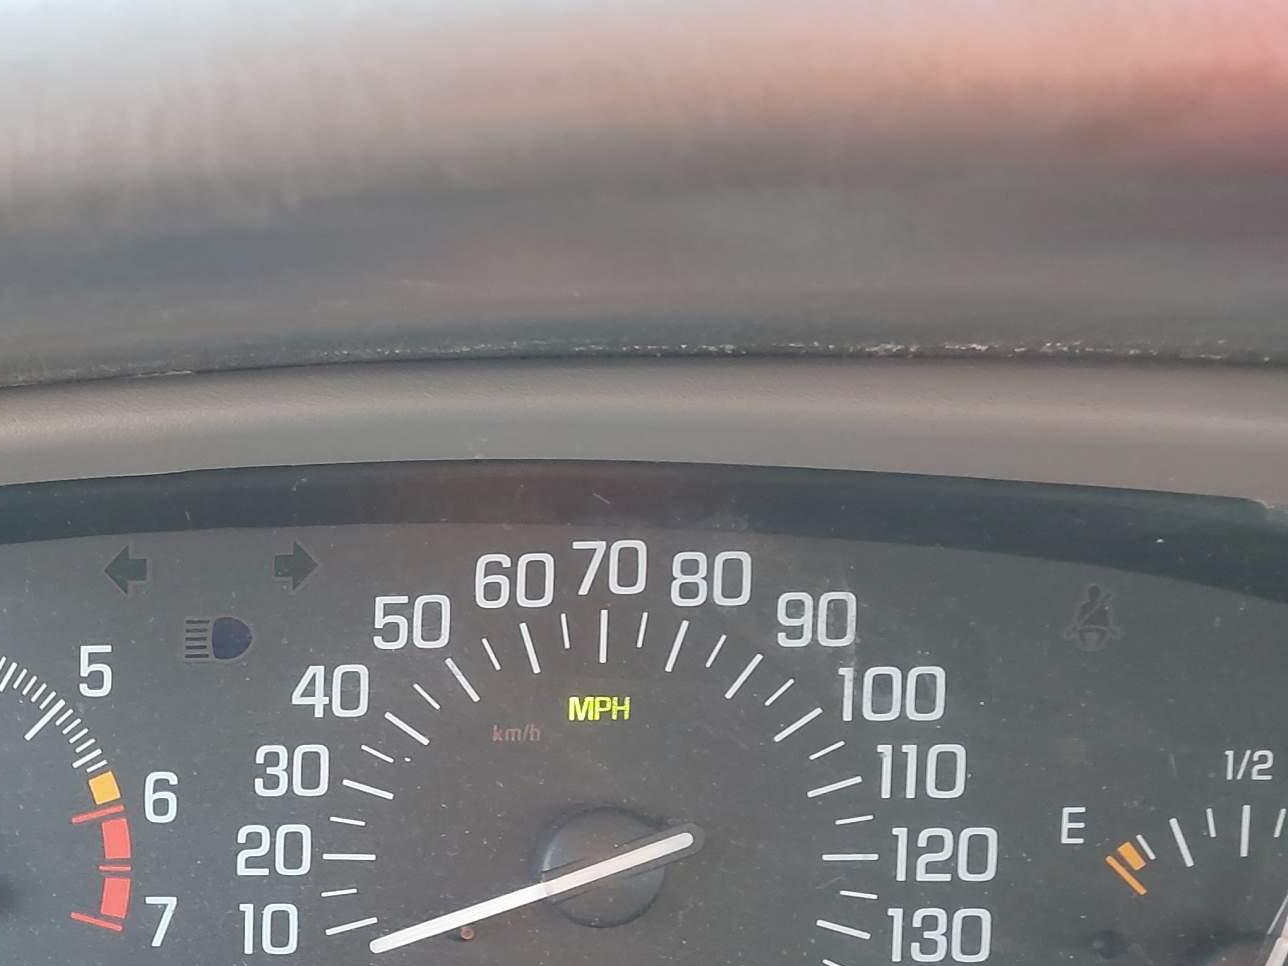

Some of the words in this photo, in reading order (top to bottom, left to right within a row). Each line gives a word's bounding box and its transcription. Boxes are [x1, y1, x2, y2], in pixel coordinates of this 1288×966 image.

[474, 552, 555, 609] 60
[571, 539, 648, 596] 70
[670, 550, 752, 607] 80
[372, 594, 451, 651] 50
[776, 591, 857, 648] 90
[78, 644, 113, 698] 5
[290, 663, 370, 718] 40
[838, 665, 947, 722] 100
[491, 723, 542, 743] km/h
[567, 695, 632, 722] MPH
[253, 744, 330, 798] 30
[876, 743, 968, 800] 110
[1224, 749, 1274, 781] 1/2
[144, 770, 179, 825] 6
[236, 823, 312, 877] 20
[1061, 806, 1087, 845] E
[891, 826, 1000, 883] 120
[144, 896, 178, 948] 7
[238, 902, 299, 956] 10
[887, 907, 994, 964] 130
